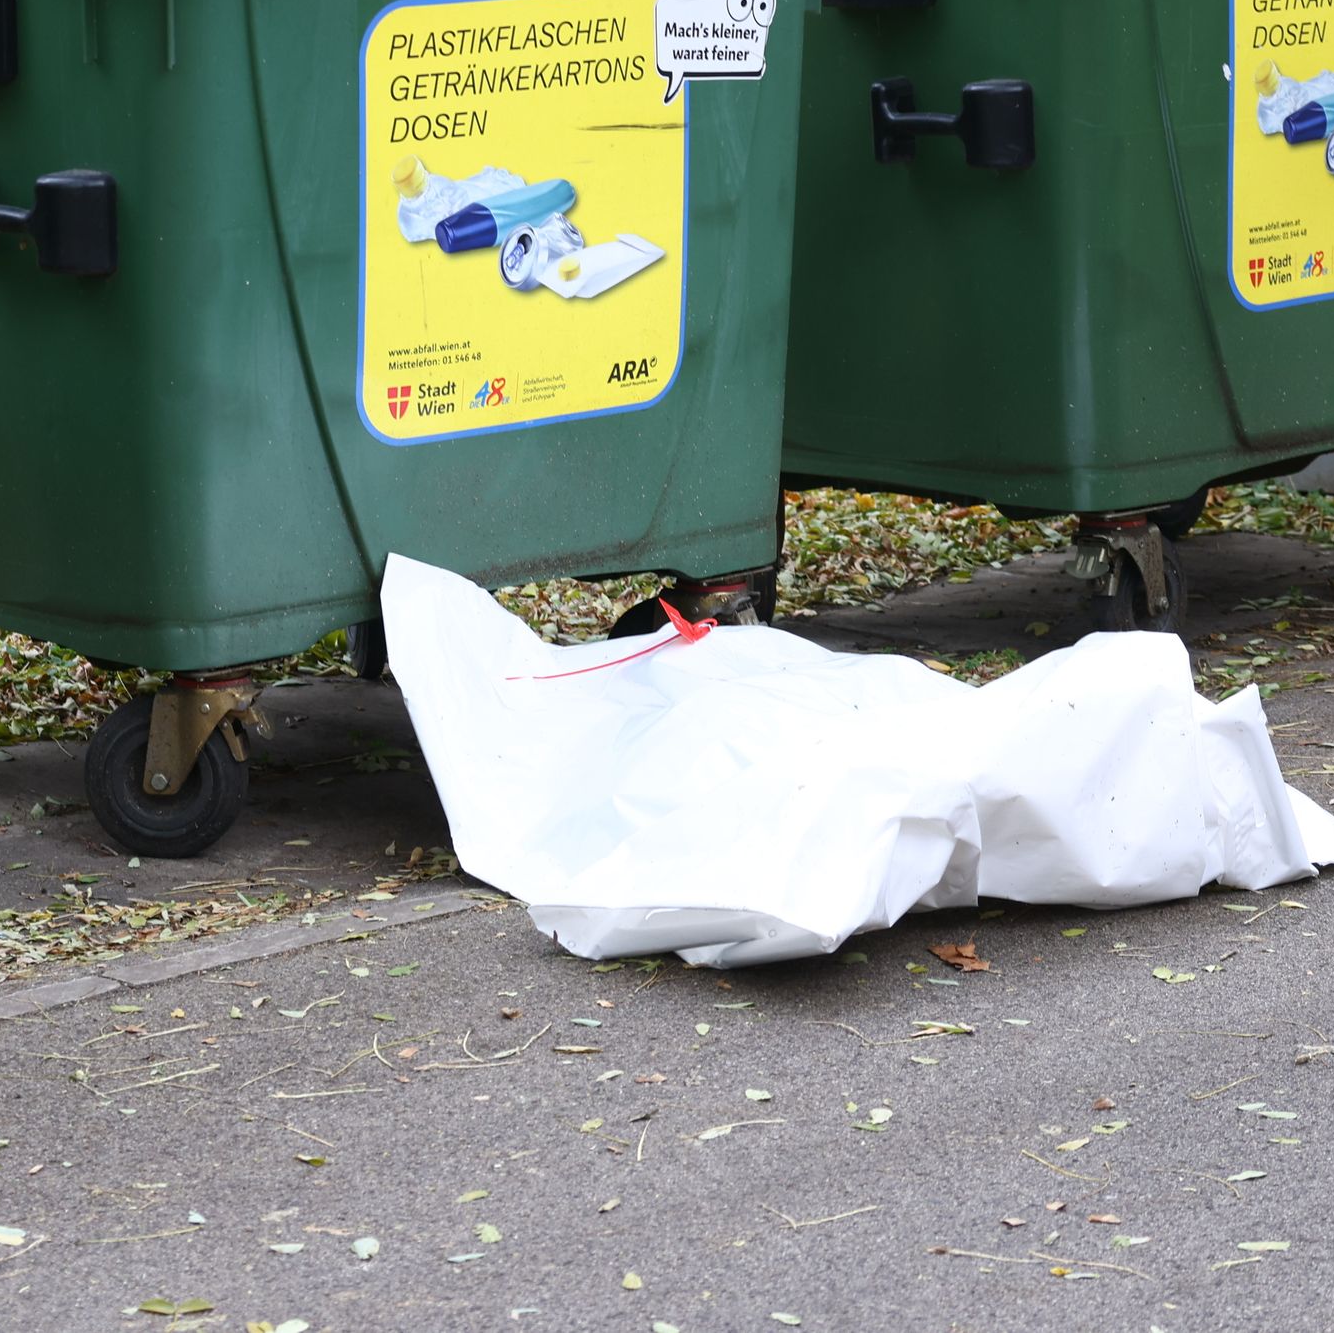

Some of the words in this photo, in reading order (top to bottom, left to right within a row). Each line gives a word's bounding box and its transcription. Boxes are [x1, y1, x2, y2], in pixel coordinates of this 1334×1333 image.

[389, 17, 627, 61] PLASTIKFLASCHEN
[664, 22, 709, 38] Mach's
[712, 23, 759, 43] kleiner,
[1253, 21, 1327, 49] DOSEN
[673, 47, 709, 60] warat
[712, 45, 749, 61] feiner
[390, 54, 645, 102] GETRÄNKEKARTONS
[390, 109, 488, 143] DOSEN
[1268, 254, 1292, 270] Stadt
[1268, 271, 1292, 286] Wien
[388, 340, 471, 357] www.abfall.wien.at
[388, 358, 441, 371] Misttelefon:
[442, 356, 453, 366] 01
[455, 353, 470, 364] 546
[471, 351, 482, 361] 48
[607, 358, 650, 384] ARA
[418, 381, 457, 399] Stadt
[418, 400, 455, 418] Wien
